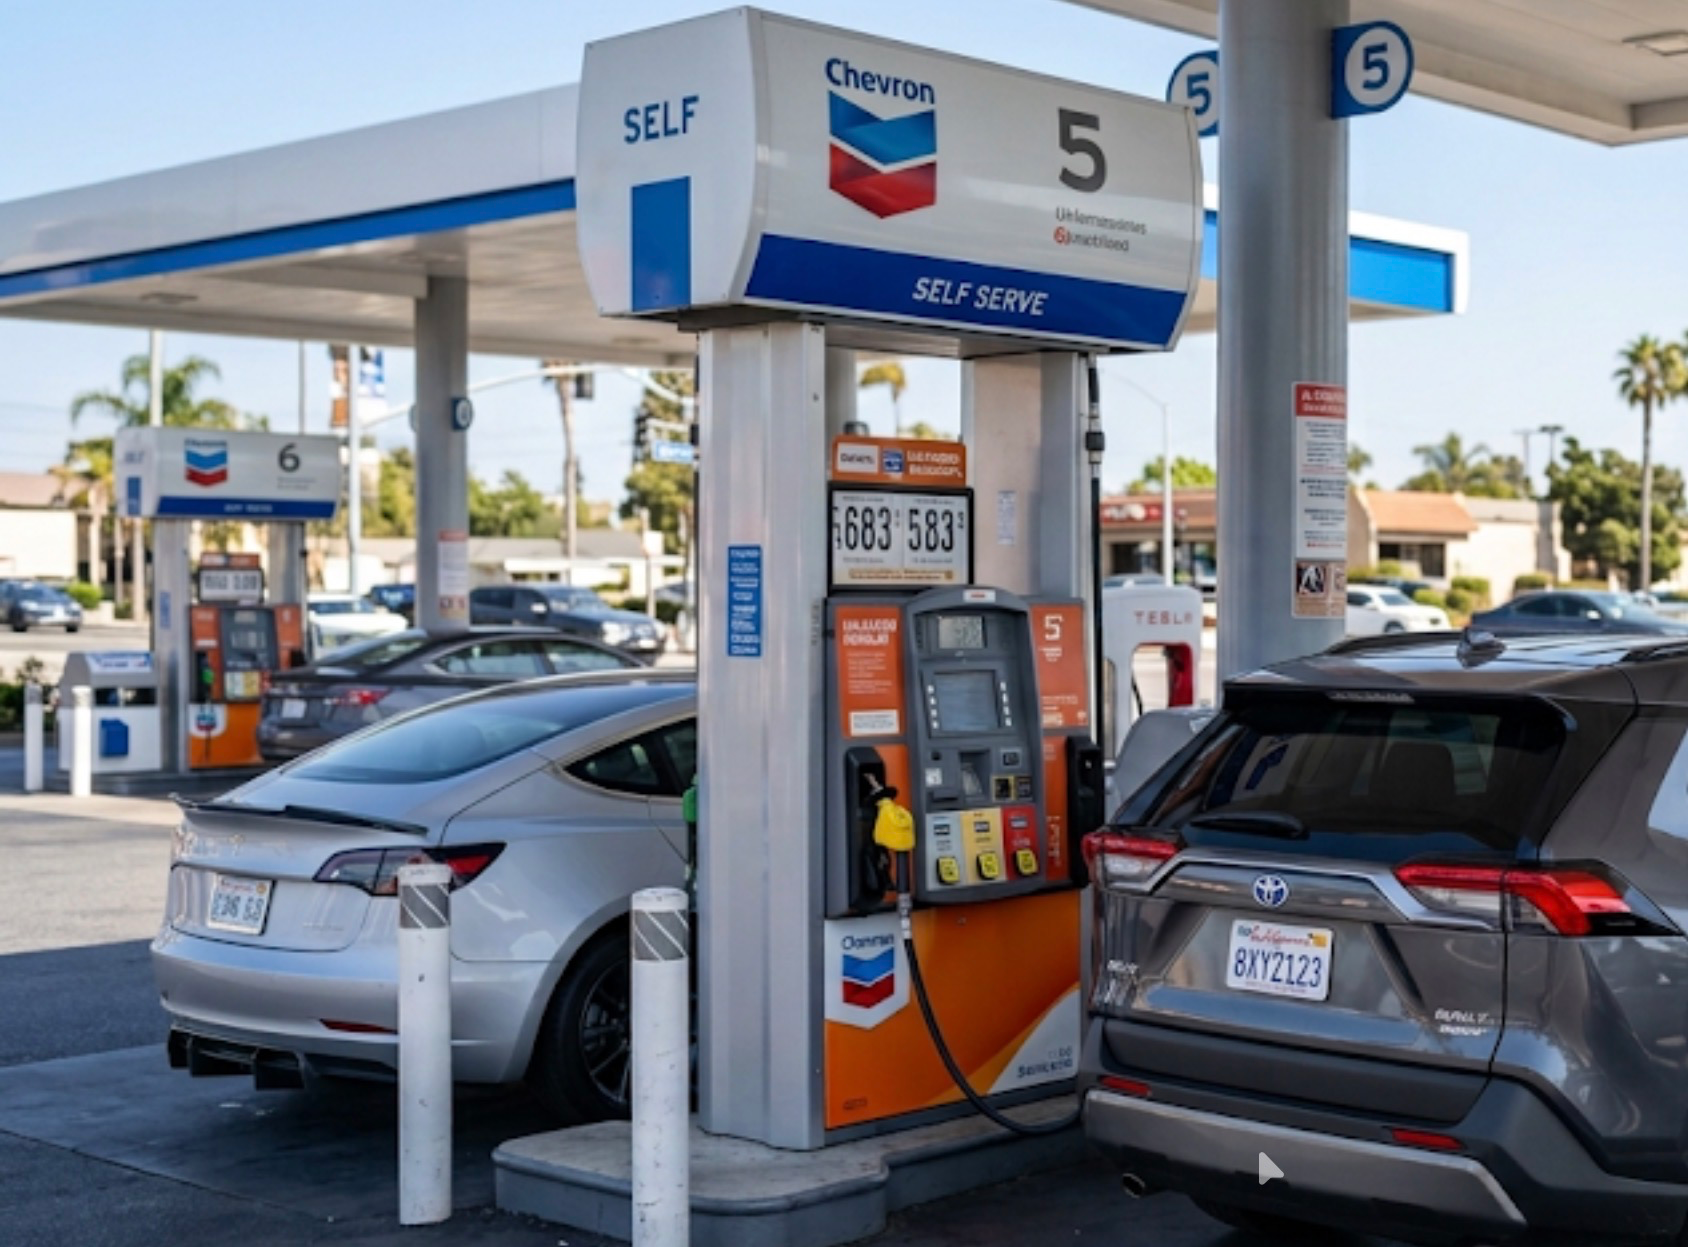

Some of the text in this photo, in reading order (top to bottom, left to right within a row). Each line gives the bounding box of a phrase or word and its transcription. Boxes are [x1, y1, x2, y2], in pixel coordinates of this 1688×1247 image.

[825, 57, 935, 105] Chevron
[1362, 42, 1389, 90] 5
[1186, 71, 1211, 116] 5
[624, 95, 699, 145] SELF
[1058, 107, 1107, 193] 5
[912, 277, 1049, 316] SELF SERVE
[278, 442, 300, 473] 6
[1045, 614, 1064, 641] 5
